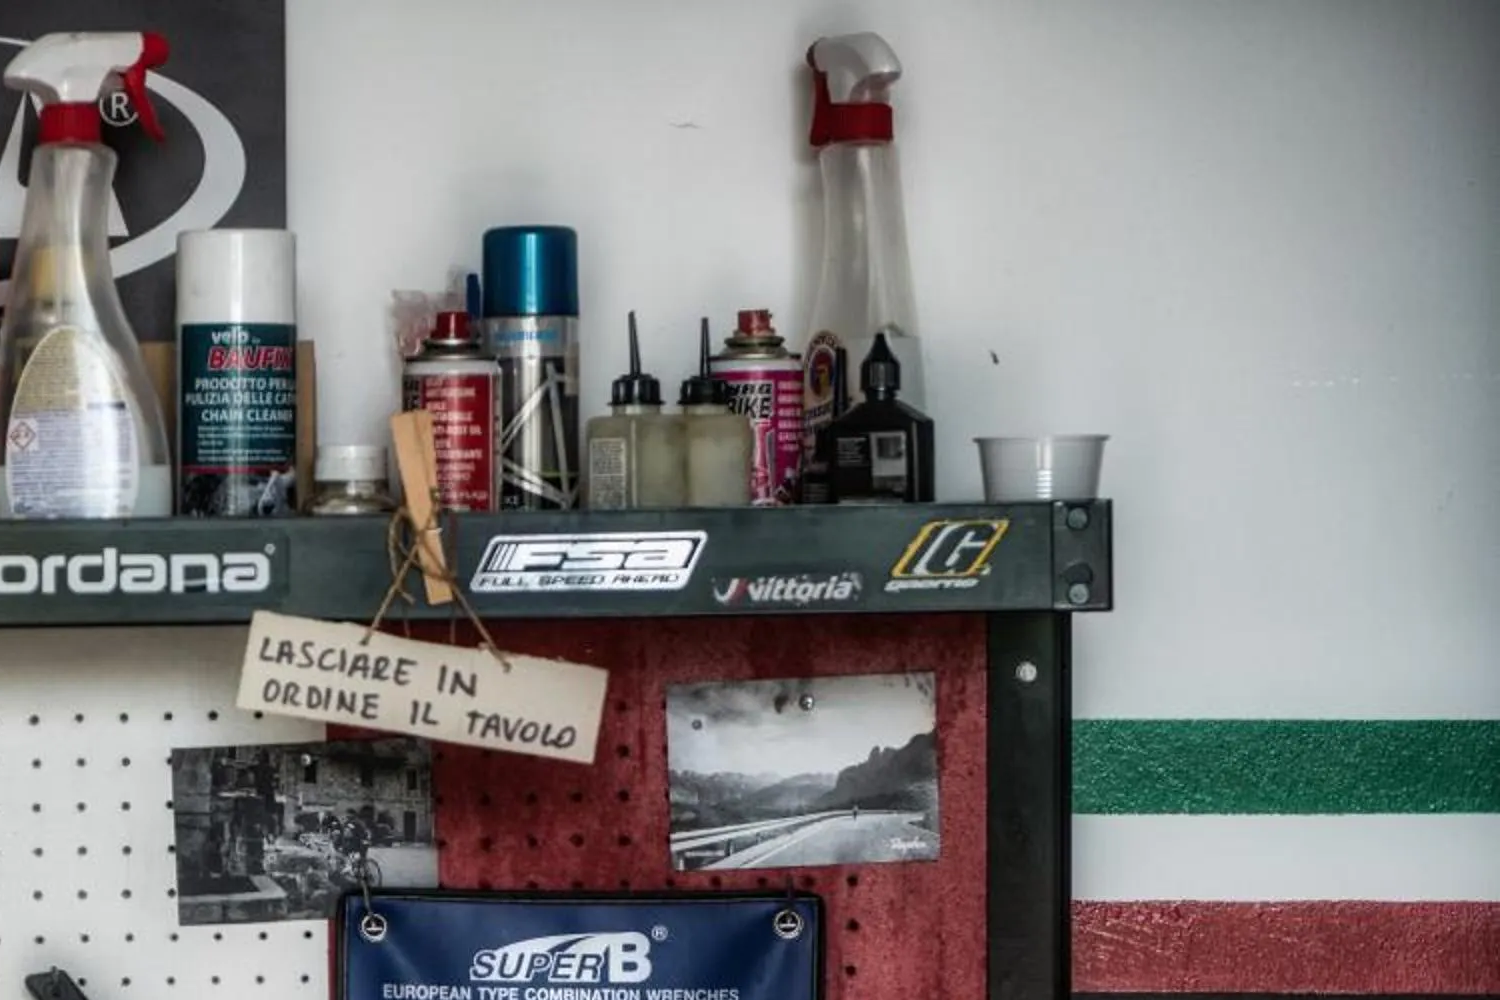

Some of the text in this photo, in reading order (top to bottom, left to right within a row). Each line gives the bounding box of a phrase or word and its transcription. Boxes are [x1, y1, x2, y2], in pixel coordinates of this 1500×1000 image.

[201, 408, 243, 422] CHAIN
[479, 572, 680, 588] FULL SPEED AHEAD
[746, 572, 855, 602] vittoria
[259, 637, 478, 697] LASCIARE IN
[262, 679, 579, 749] ORDINE IL TAVOLO
[470, 949, 604, 983] SUPER
[383, 984, 471, 1000] EUROPEAN
